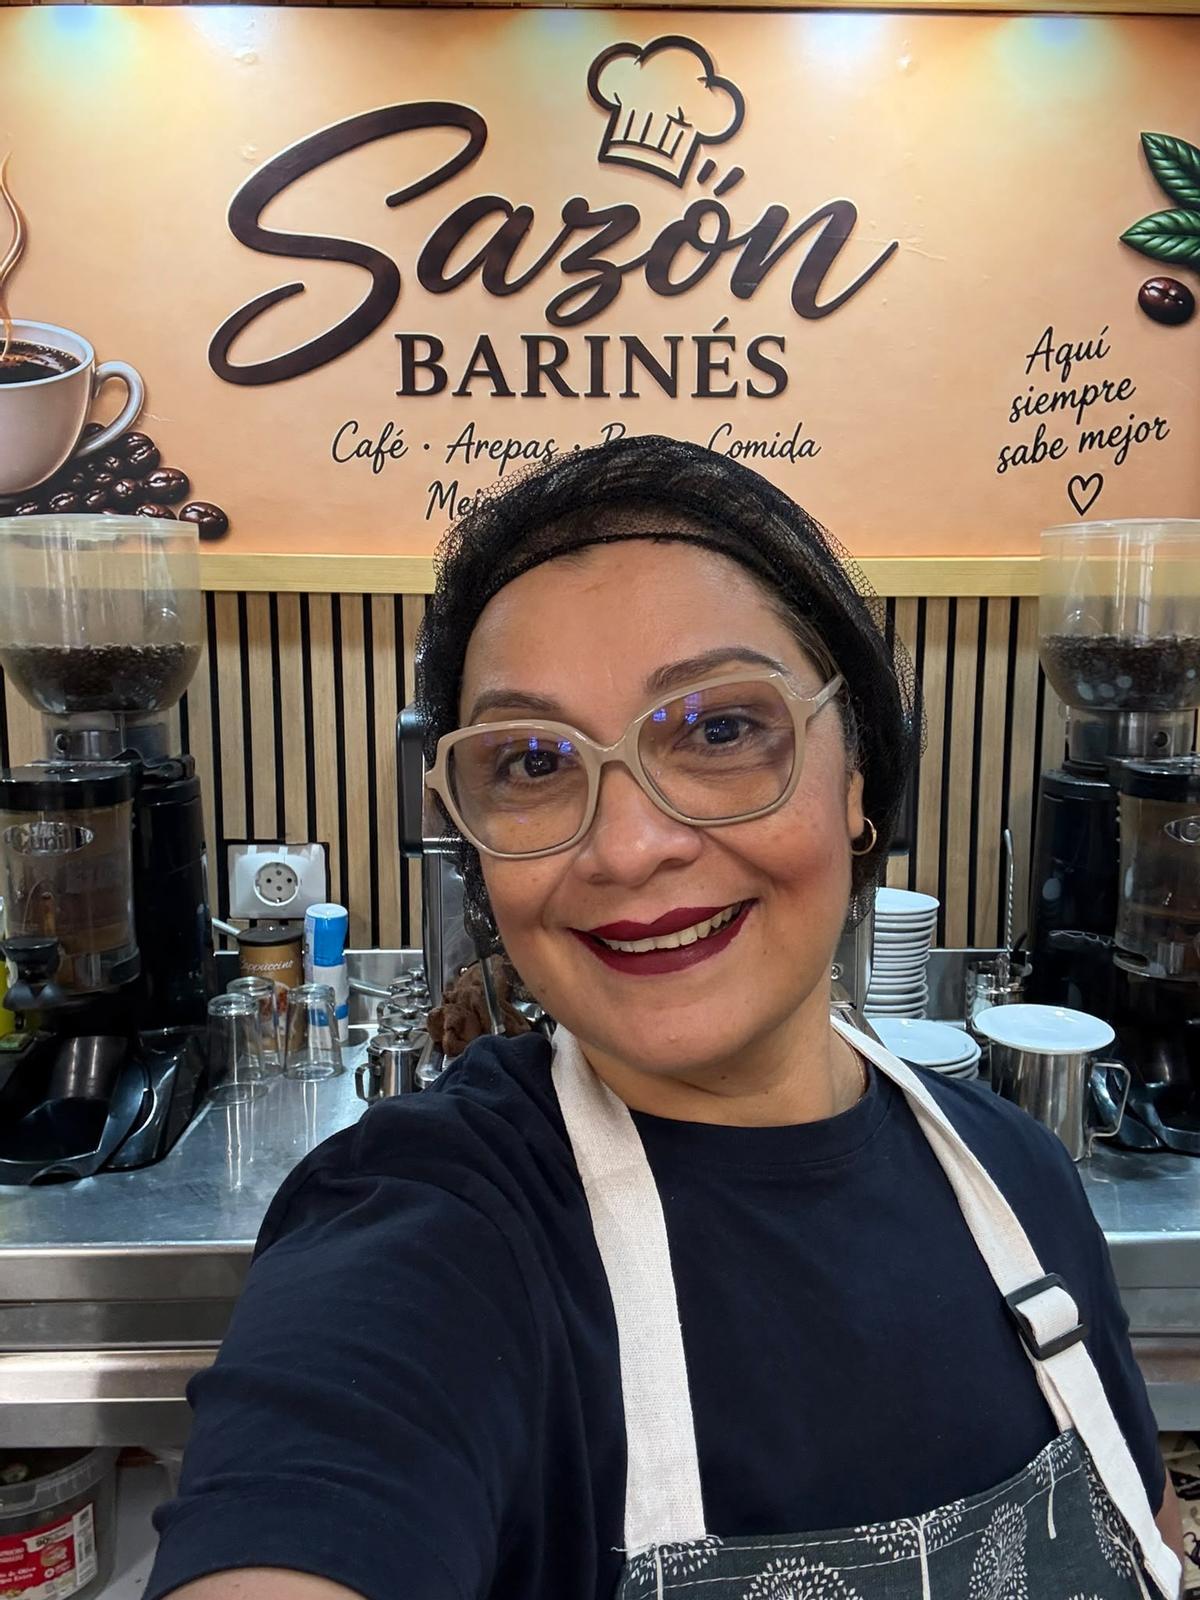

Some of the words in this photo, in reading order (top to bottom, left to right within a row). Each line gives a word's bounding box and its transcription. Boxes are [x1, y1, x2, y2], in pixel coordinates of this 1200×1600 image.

[208, 101, 899, 387] Sazón
[395, 317, 789, 399] BARINÉS
[1025, 325, 1111, 383] Aquí
[1009, 378, 1137, 425] siempre
[332, 420, 409, 474] Café
[445, 422, 560, 476] Arepas
[707, 421, 822, 464] Comida
[996, 423, 1068, 474] sabe
[1078, 413, 1170, 466] mejor
